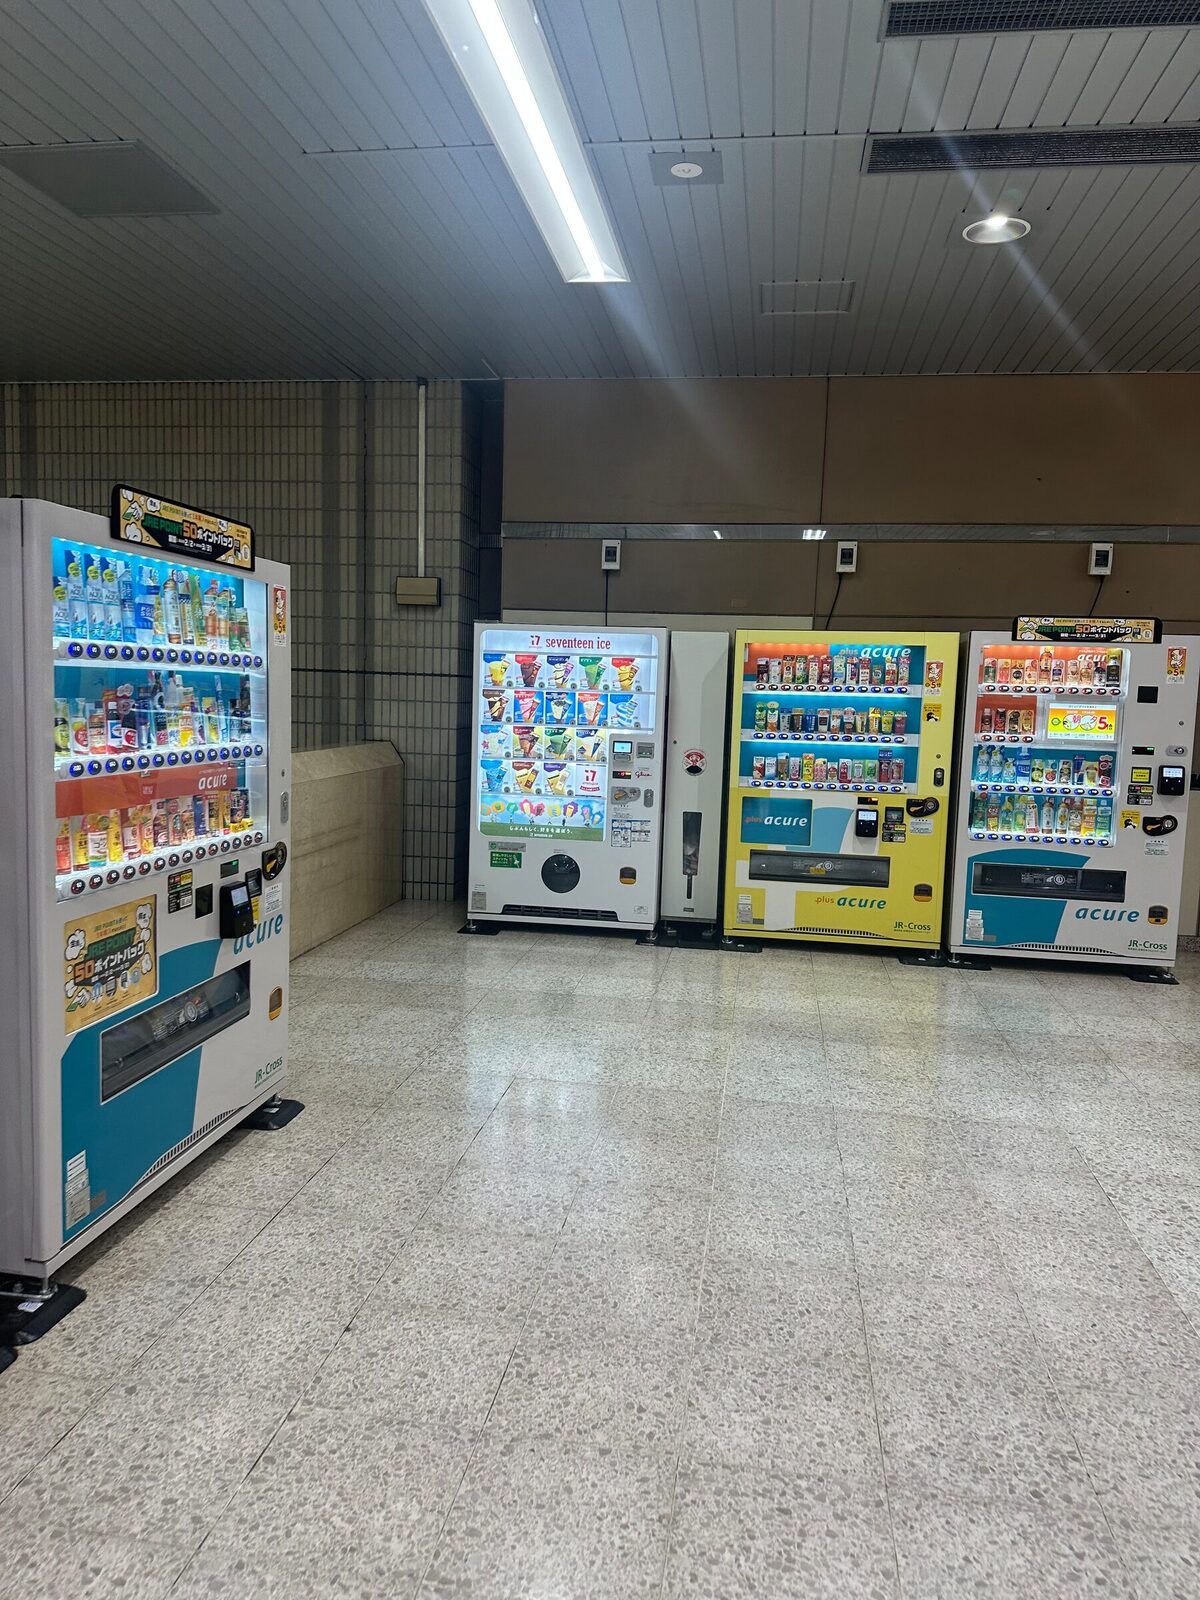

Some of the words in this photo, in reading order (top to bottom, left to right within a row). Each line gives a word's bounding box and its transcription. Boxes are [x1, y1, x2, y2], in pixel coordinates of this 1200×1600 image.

[160, 520, 183, 535] POINT
[1053, 625, 1076, 633] POINT
[545, 637, 594, 649] seventeen
[597, 636, 611, 649] ice
[860, 647, 912, 658] acure
[1077, 653, 1107, 662] acur
[198, 774, 228, 790] acure
[764, 816, 808, 827] acure
[815, 896, 835, 905] plus
[837, 897, 887, 909] acure
[1075, 907, 1140, 922] acure
[893, 921, 931, 931] JR-Cross
[233, 914, 283, 955] acure
[1127, 939, 1168, 951] JR-Cross
[254, 1055, 283, 1084] JR-Cross
